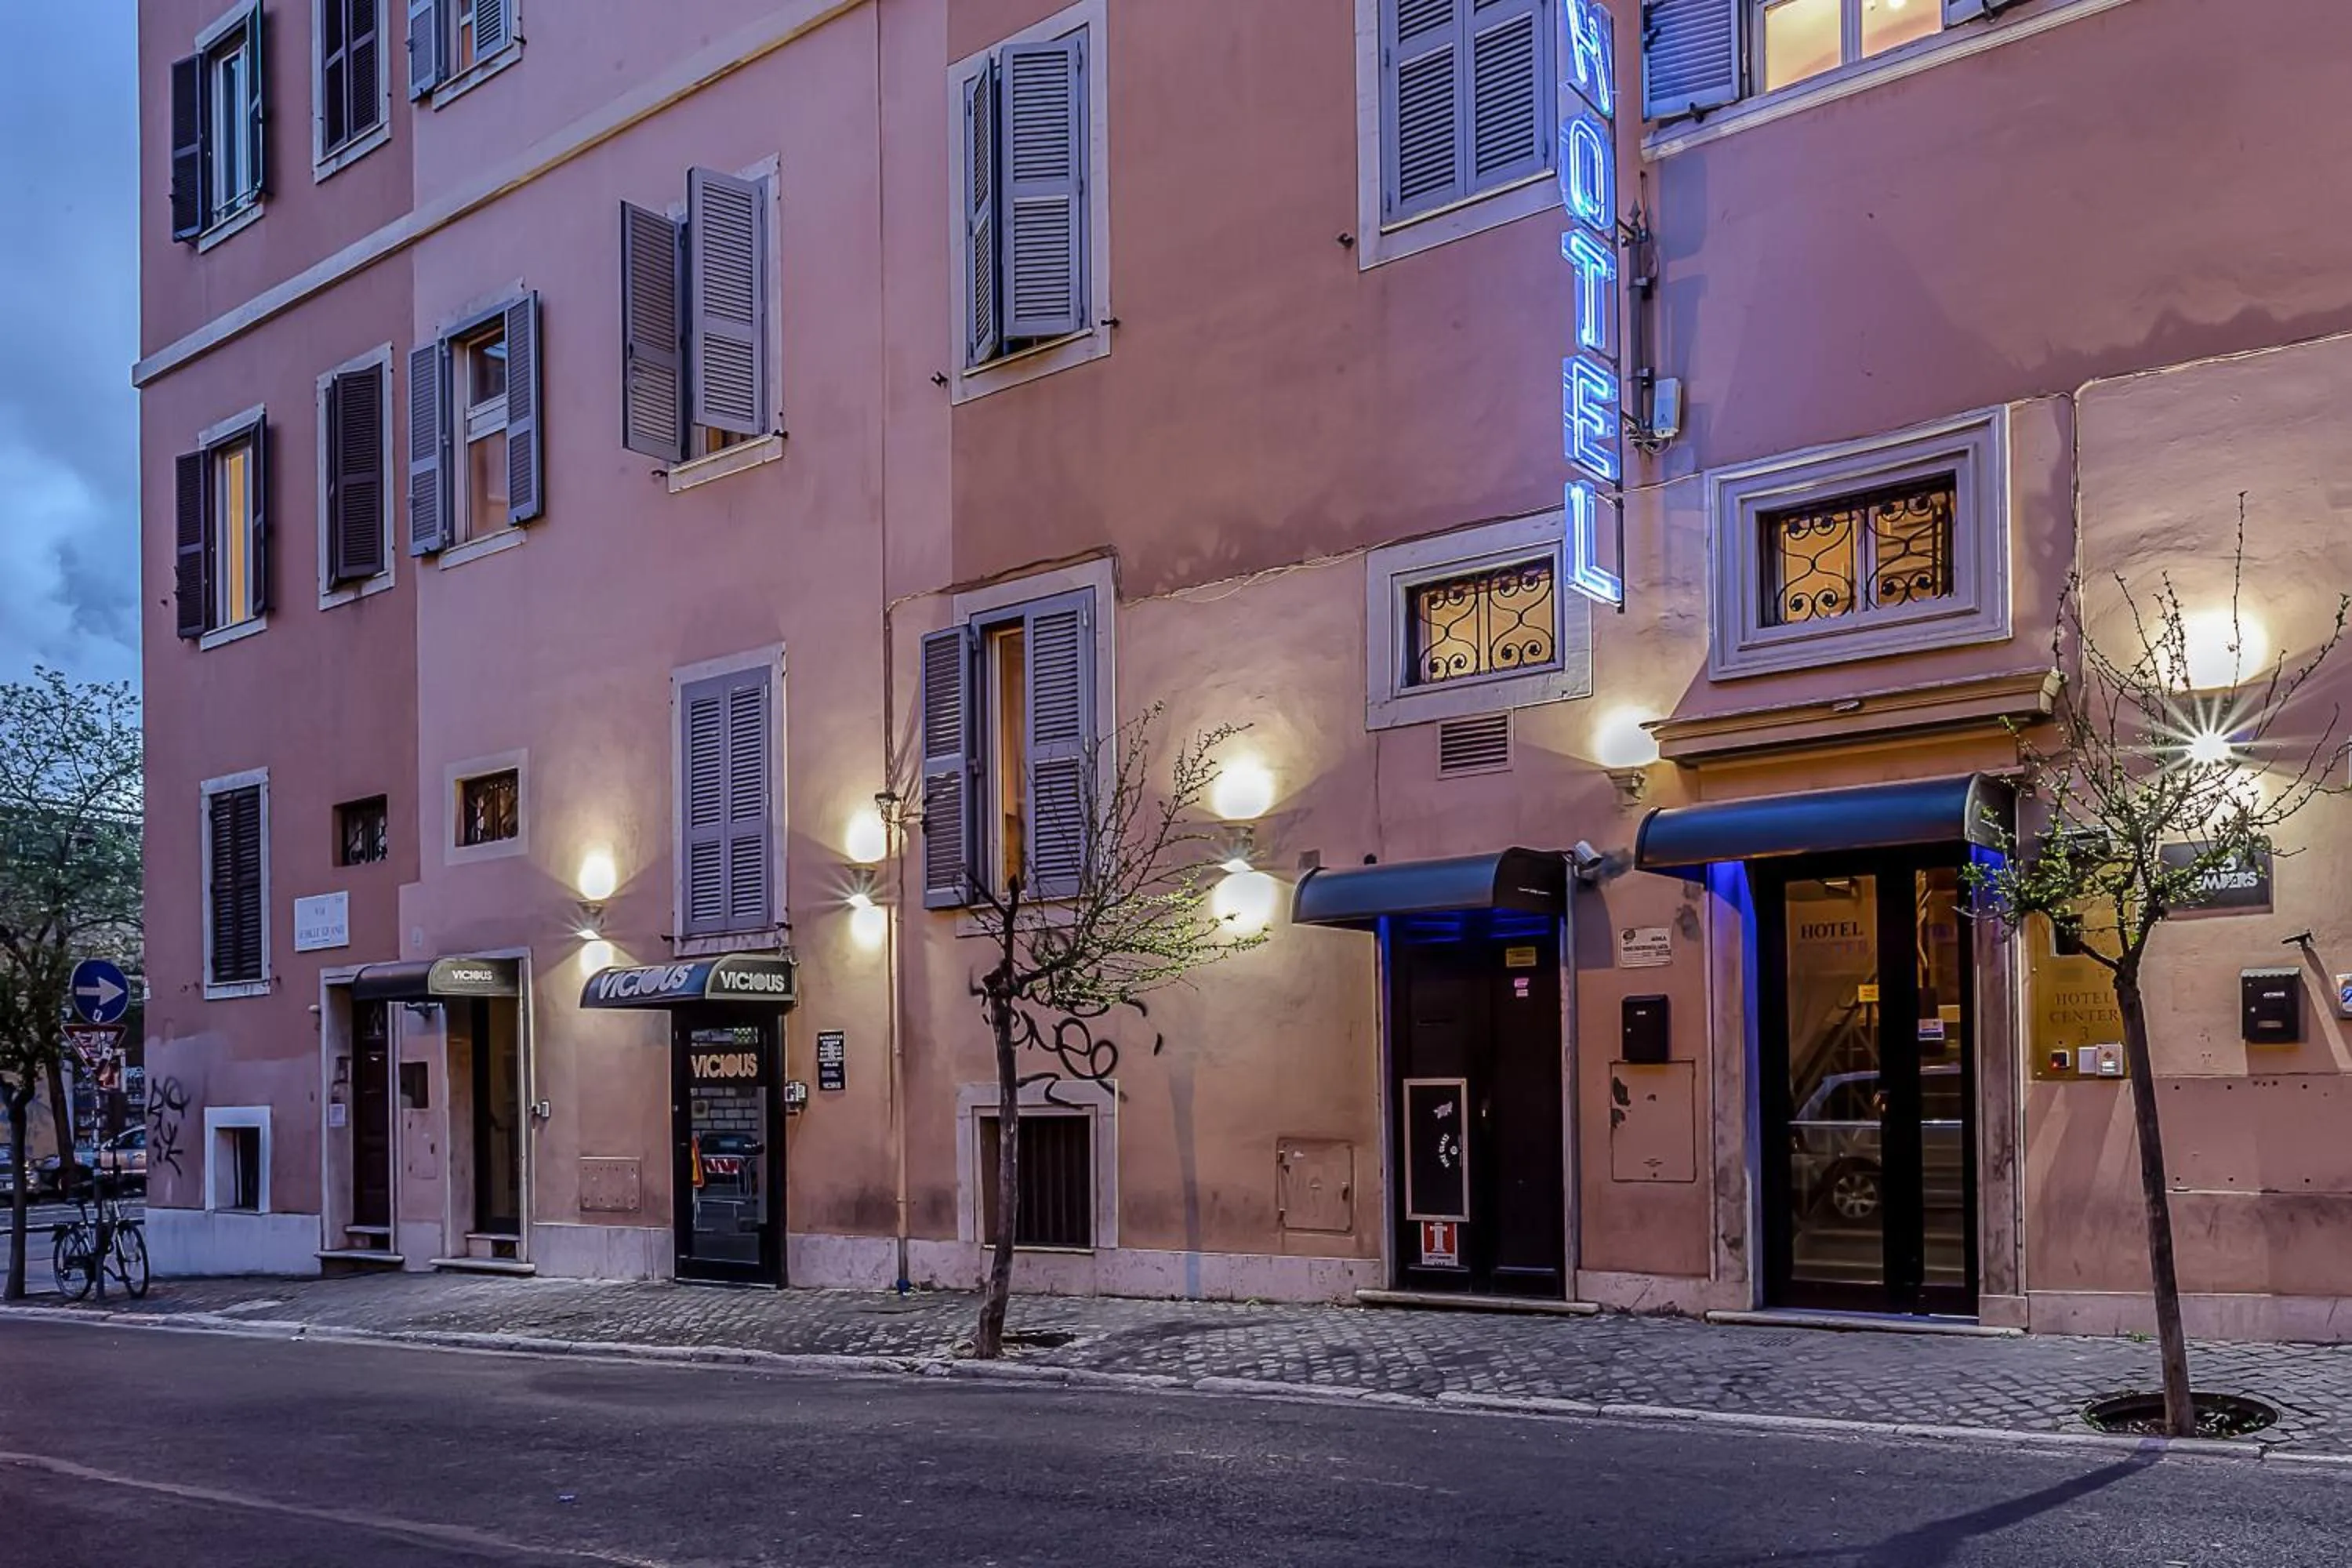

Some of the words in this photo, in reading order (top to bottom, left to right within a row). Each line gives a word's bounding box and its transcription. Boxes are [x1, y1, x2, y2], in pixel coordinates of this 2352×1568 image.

[1563, 0, 1622, 605] HOTEL
[1801, 921, 1864, 939] HOTEL
[451, 970, 493, 981] VICIOUS
[598, 963, 695, 1000] VICIOUS
[719, 970, 785, 992] VICIOUS
[2055, 991, 2111, 1006] HOTEL
[2049, 1009, 2119, 1024] CENTER
[2081, 1026, 2089, 1042] 3
[690, 1053, 758, 1078] VICIOUS
